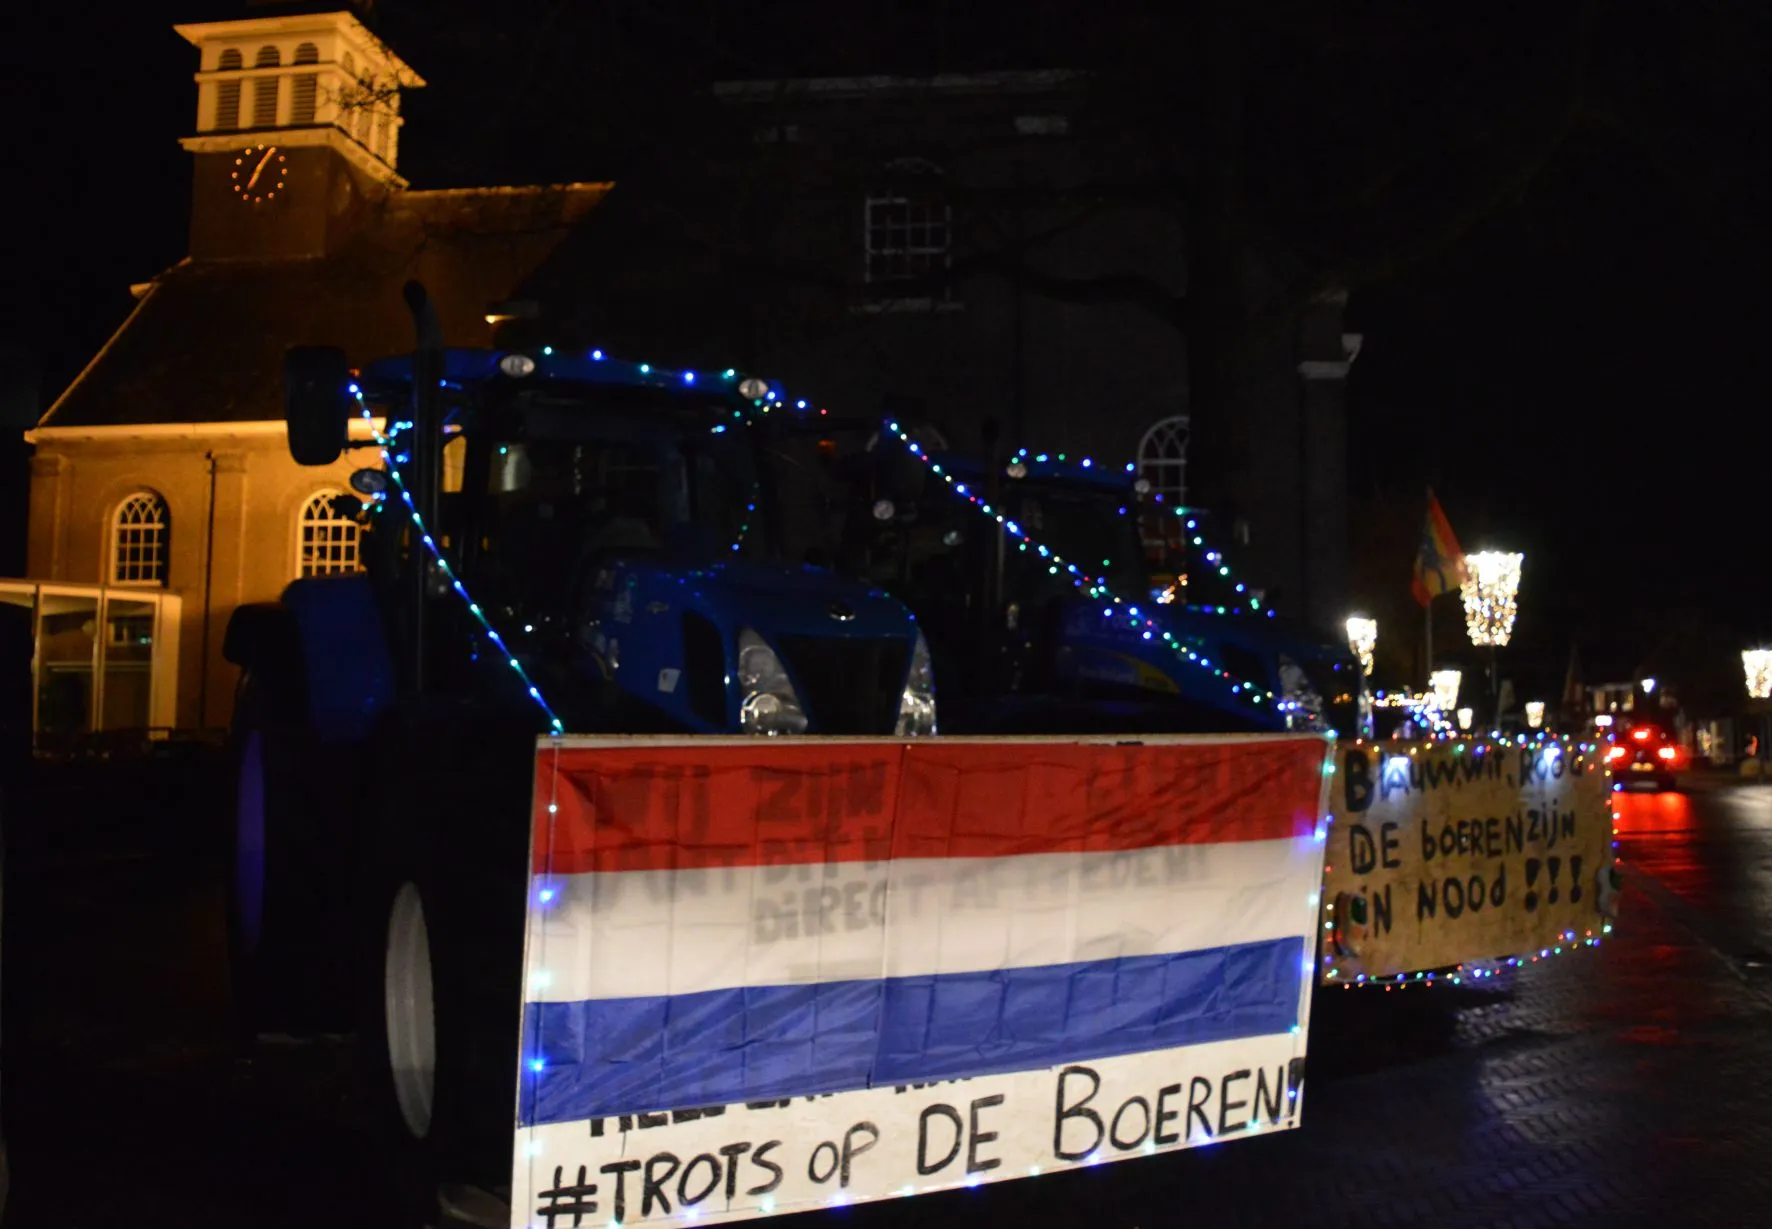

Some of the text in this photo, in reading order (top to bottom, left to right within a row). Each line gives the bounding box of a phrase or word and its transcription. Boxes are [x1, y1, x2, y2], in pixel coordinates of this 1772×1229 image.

[1351, 821, 1400, 874] DE
[536, 1140, 783, 1228] #TROTS
[808, 1120, 880, 1188] OP
[916, 1093, 1004, 1176] DE
